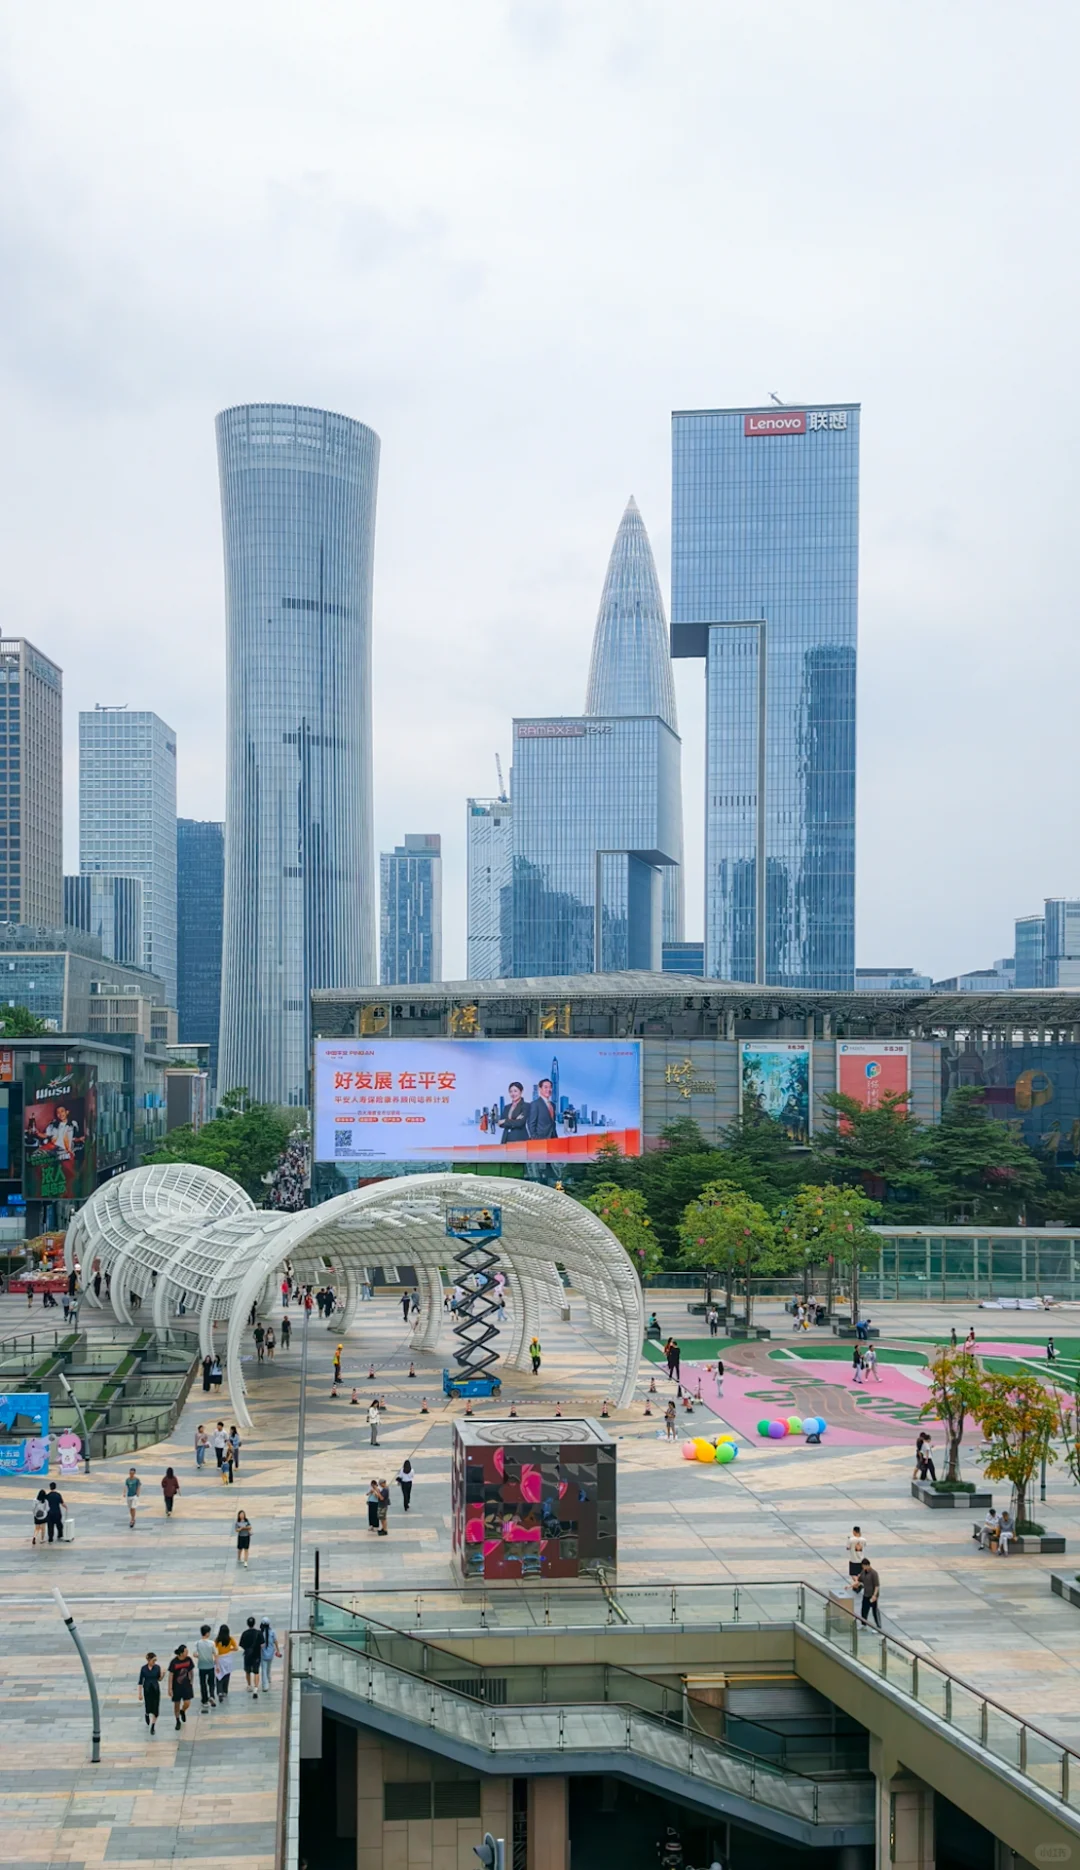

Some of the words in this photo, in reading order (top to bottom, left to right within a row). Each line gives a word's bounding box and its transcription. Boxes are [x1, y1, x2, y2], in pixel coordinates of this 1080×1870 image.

[750, 418, 801, 430] Lenovo
[808, 411, 848, 432] 联想
[334, 1071, 393, 1090] 好发展
[398, 1071, 456, 1090] 在平安
